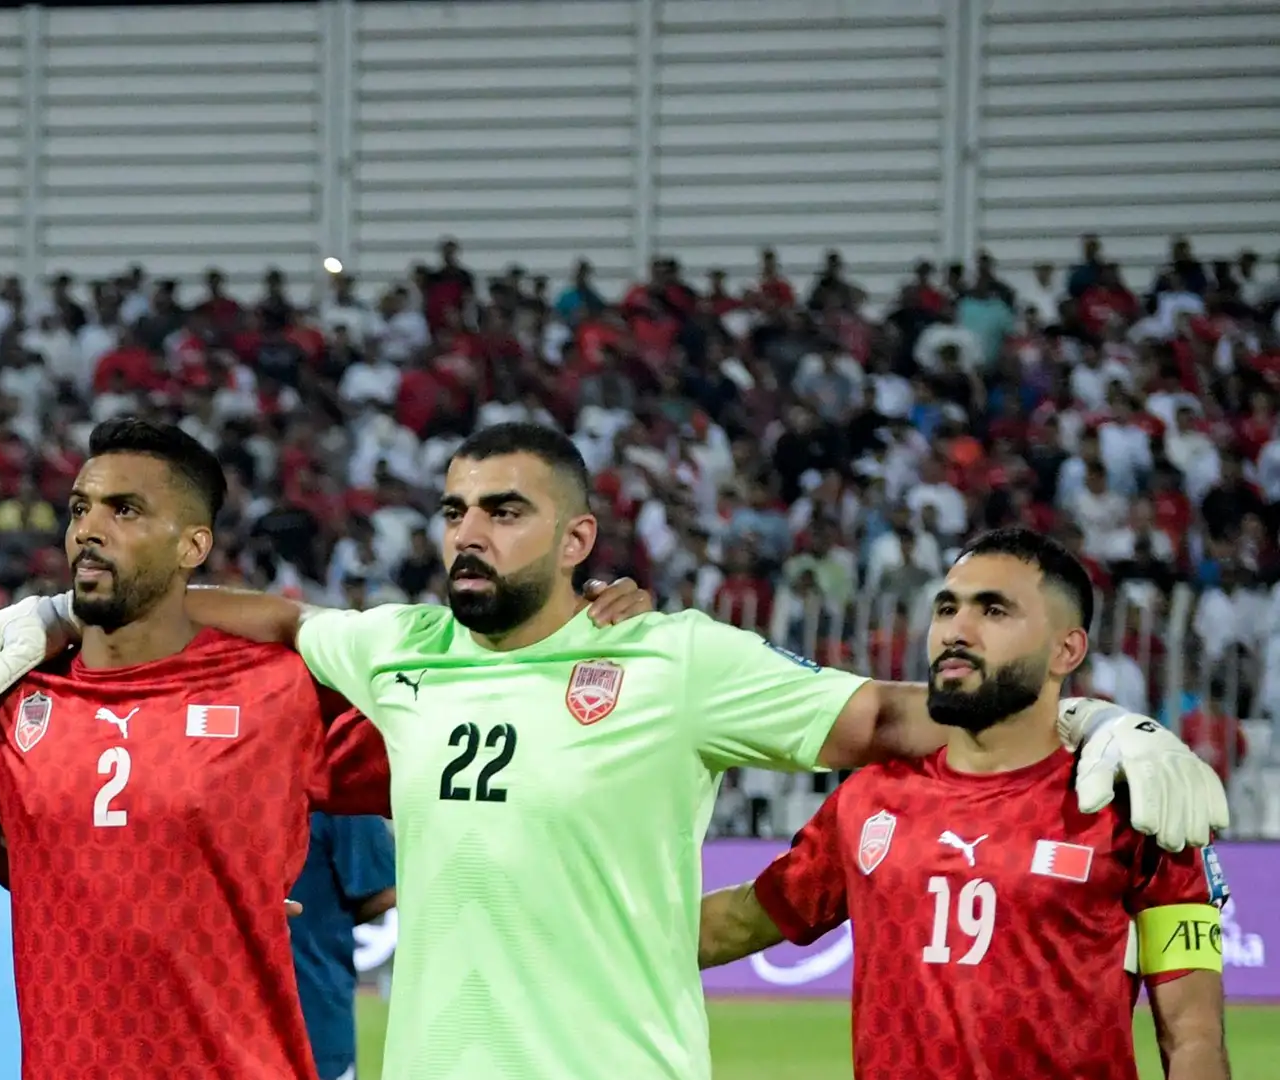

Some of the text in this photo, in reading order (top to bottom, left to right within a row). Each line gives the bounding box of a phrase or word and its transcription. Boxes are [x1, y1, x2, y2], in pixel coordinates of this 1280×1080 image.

[93, 746, 132, 827] 2
[440, 722, 517, 802] 22
[922, 876, 997, 966] 19
